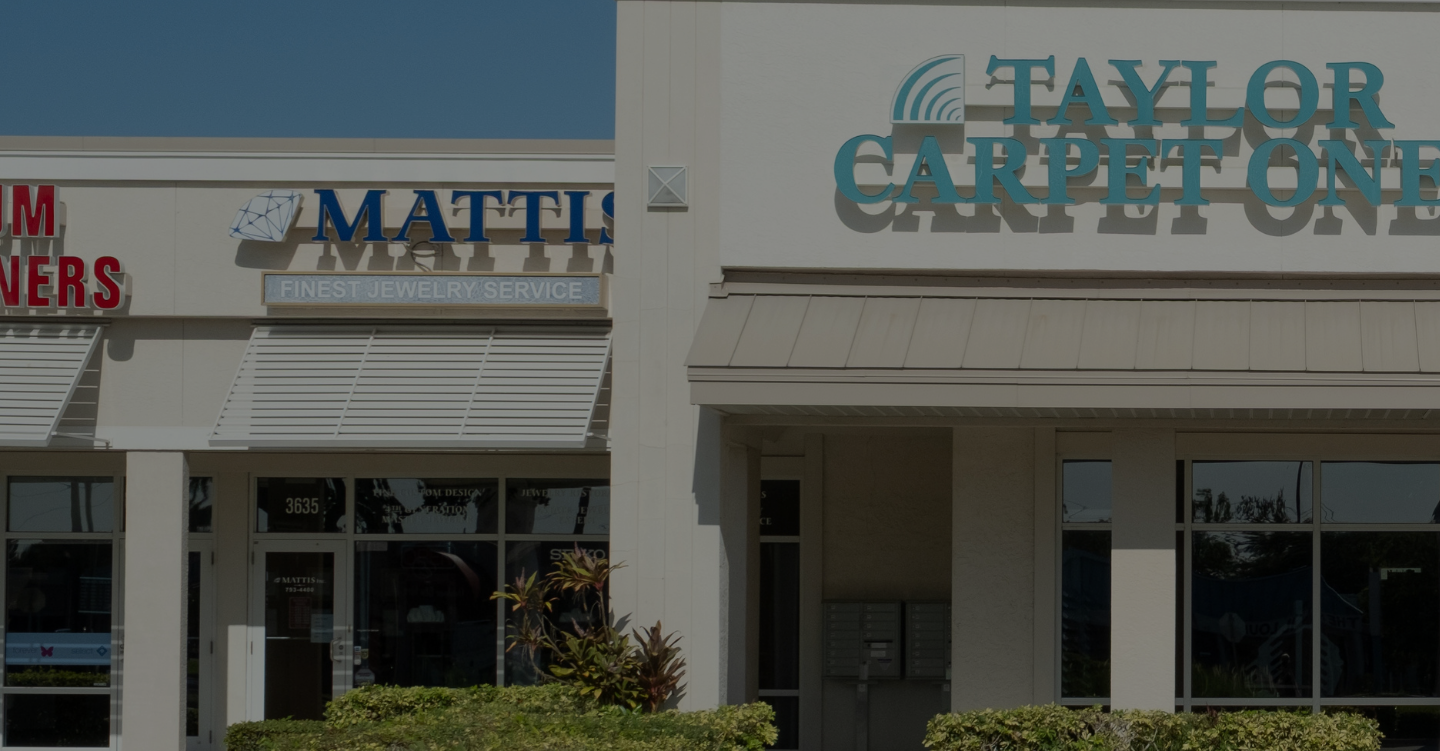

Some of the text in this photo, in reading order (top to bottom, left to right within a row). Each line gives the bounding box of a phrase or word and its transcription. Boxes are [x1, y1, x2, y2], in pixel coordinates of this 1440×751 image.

[986, 55, 1395, 129] TAYLOR
[833, 135, 1223, 205] CARPET
[280, 280, 583, 300] FINEST JEWELRY SERVICE
[285, 497, 319, 515] 3635
[550, 548, 606, 560] SEKO
